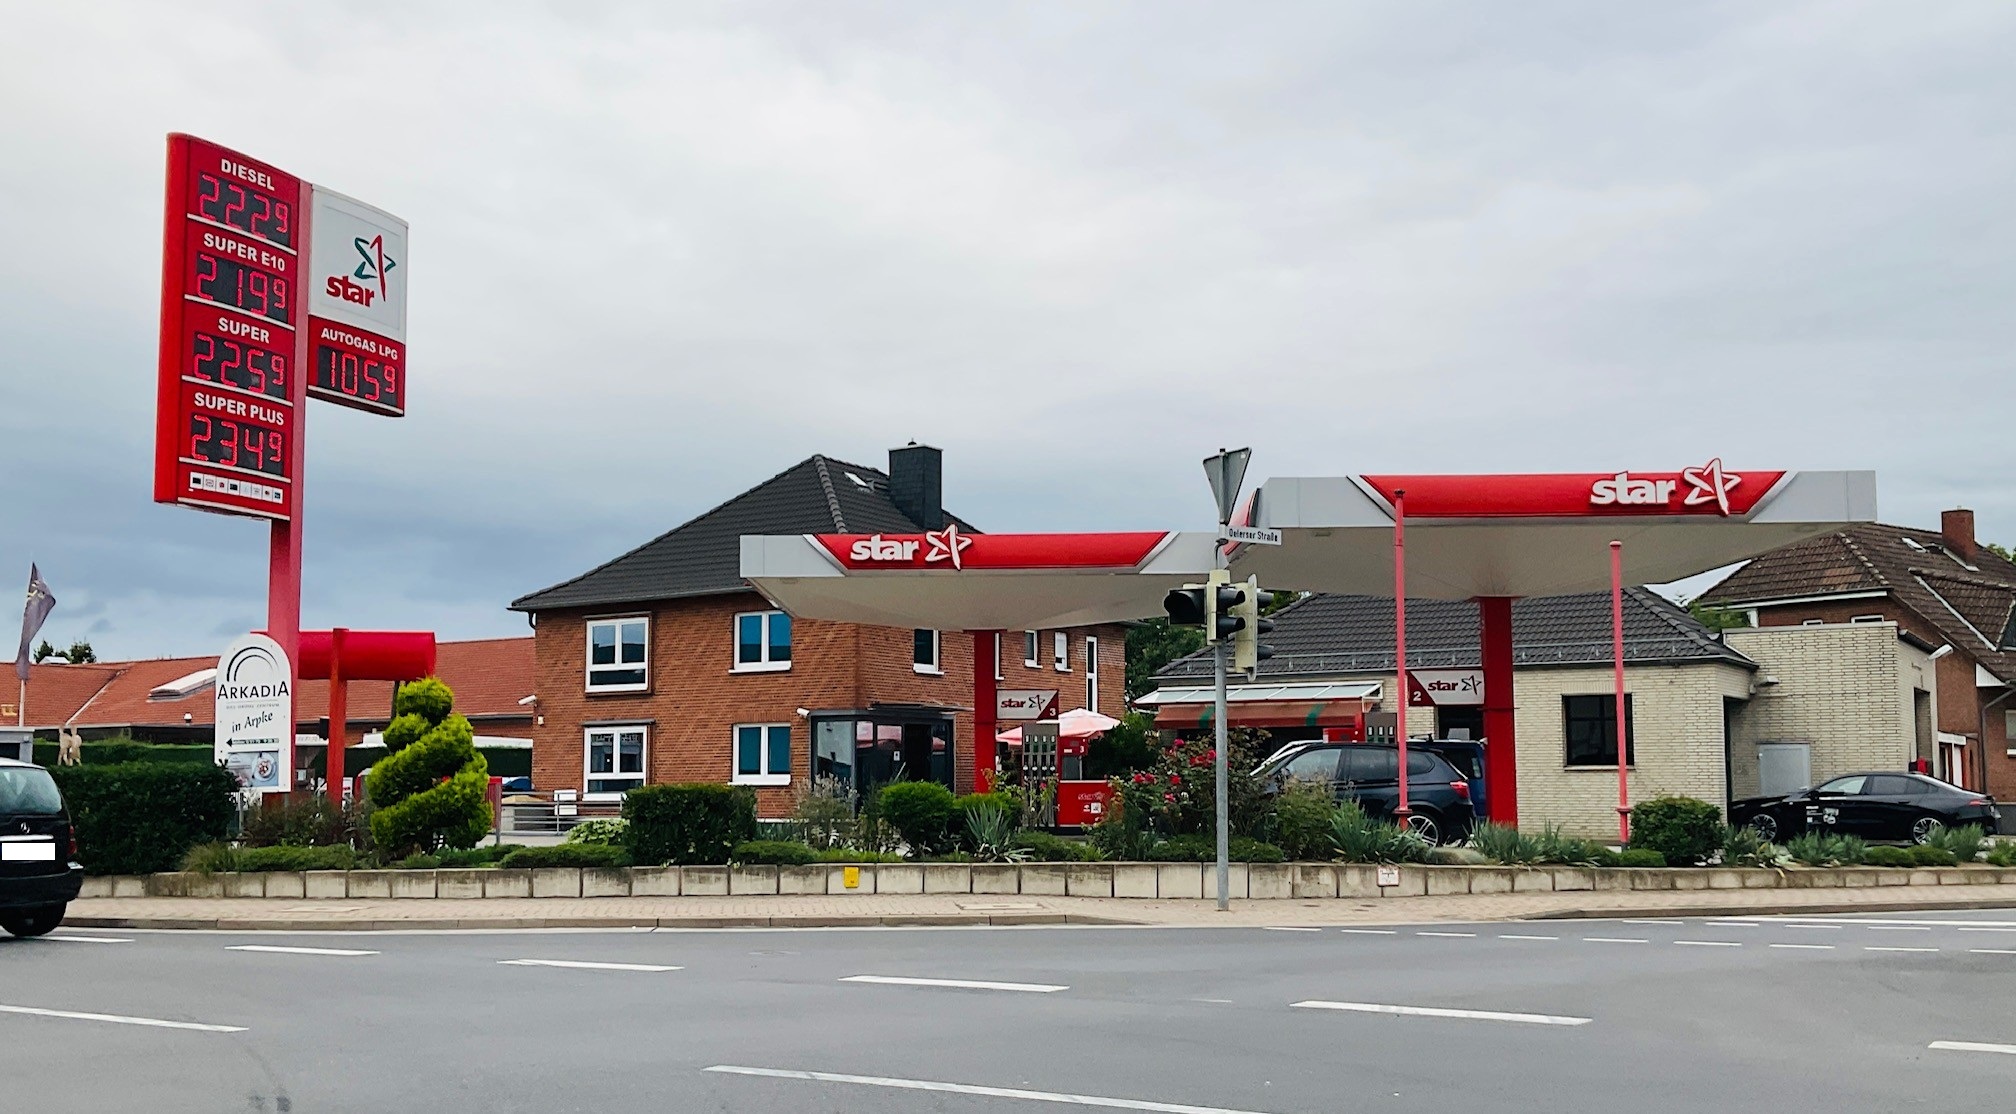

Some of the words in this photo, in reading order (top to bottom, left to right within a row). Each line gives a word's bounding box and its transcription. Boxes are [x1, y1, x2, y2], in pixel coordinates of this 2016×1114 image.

[221, 158, 275, 191] DIESEL
[203, 232, 258, 262] SUPER
[261, 251, 285, 271] E10
[326, 275, 375, 307] star
[218, 317, 270, 343] SUPER
[321, 327, 377, 354] AUTOGAS
[378, 343, 398, 360] LPG
[194, 392, 247, 416] SUPER
[250, 405, 284, 426] PLUS
[1591, 472, 1676, 505] star
[850, 534, 919, 561] star
[1257, 531, 1278, 542] Straße
[1413, 690, 1422, 702] 2
[1427, 680, 1459, 691] star
[1001, 698, 1026, 708] star
[1049, 707, 1056, 717] 3
[232, 721, 241, 733] in
[244, 710, 274, 729] Arpke
